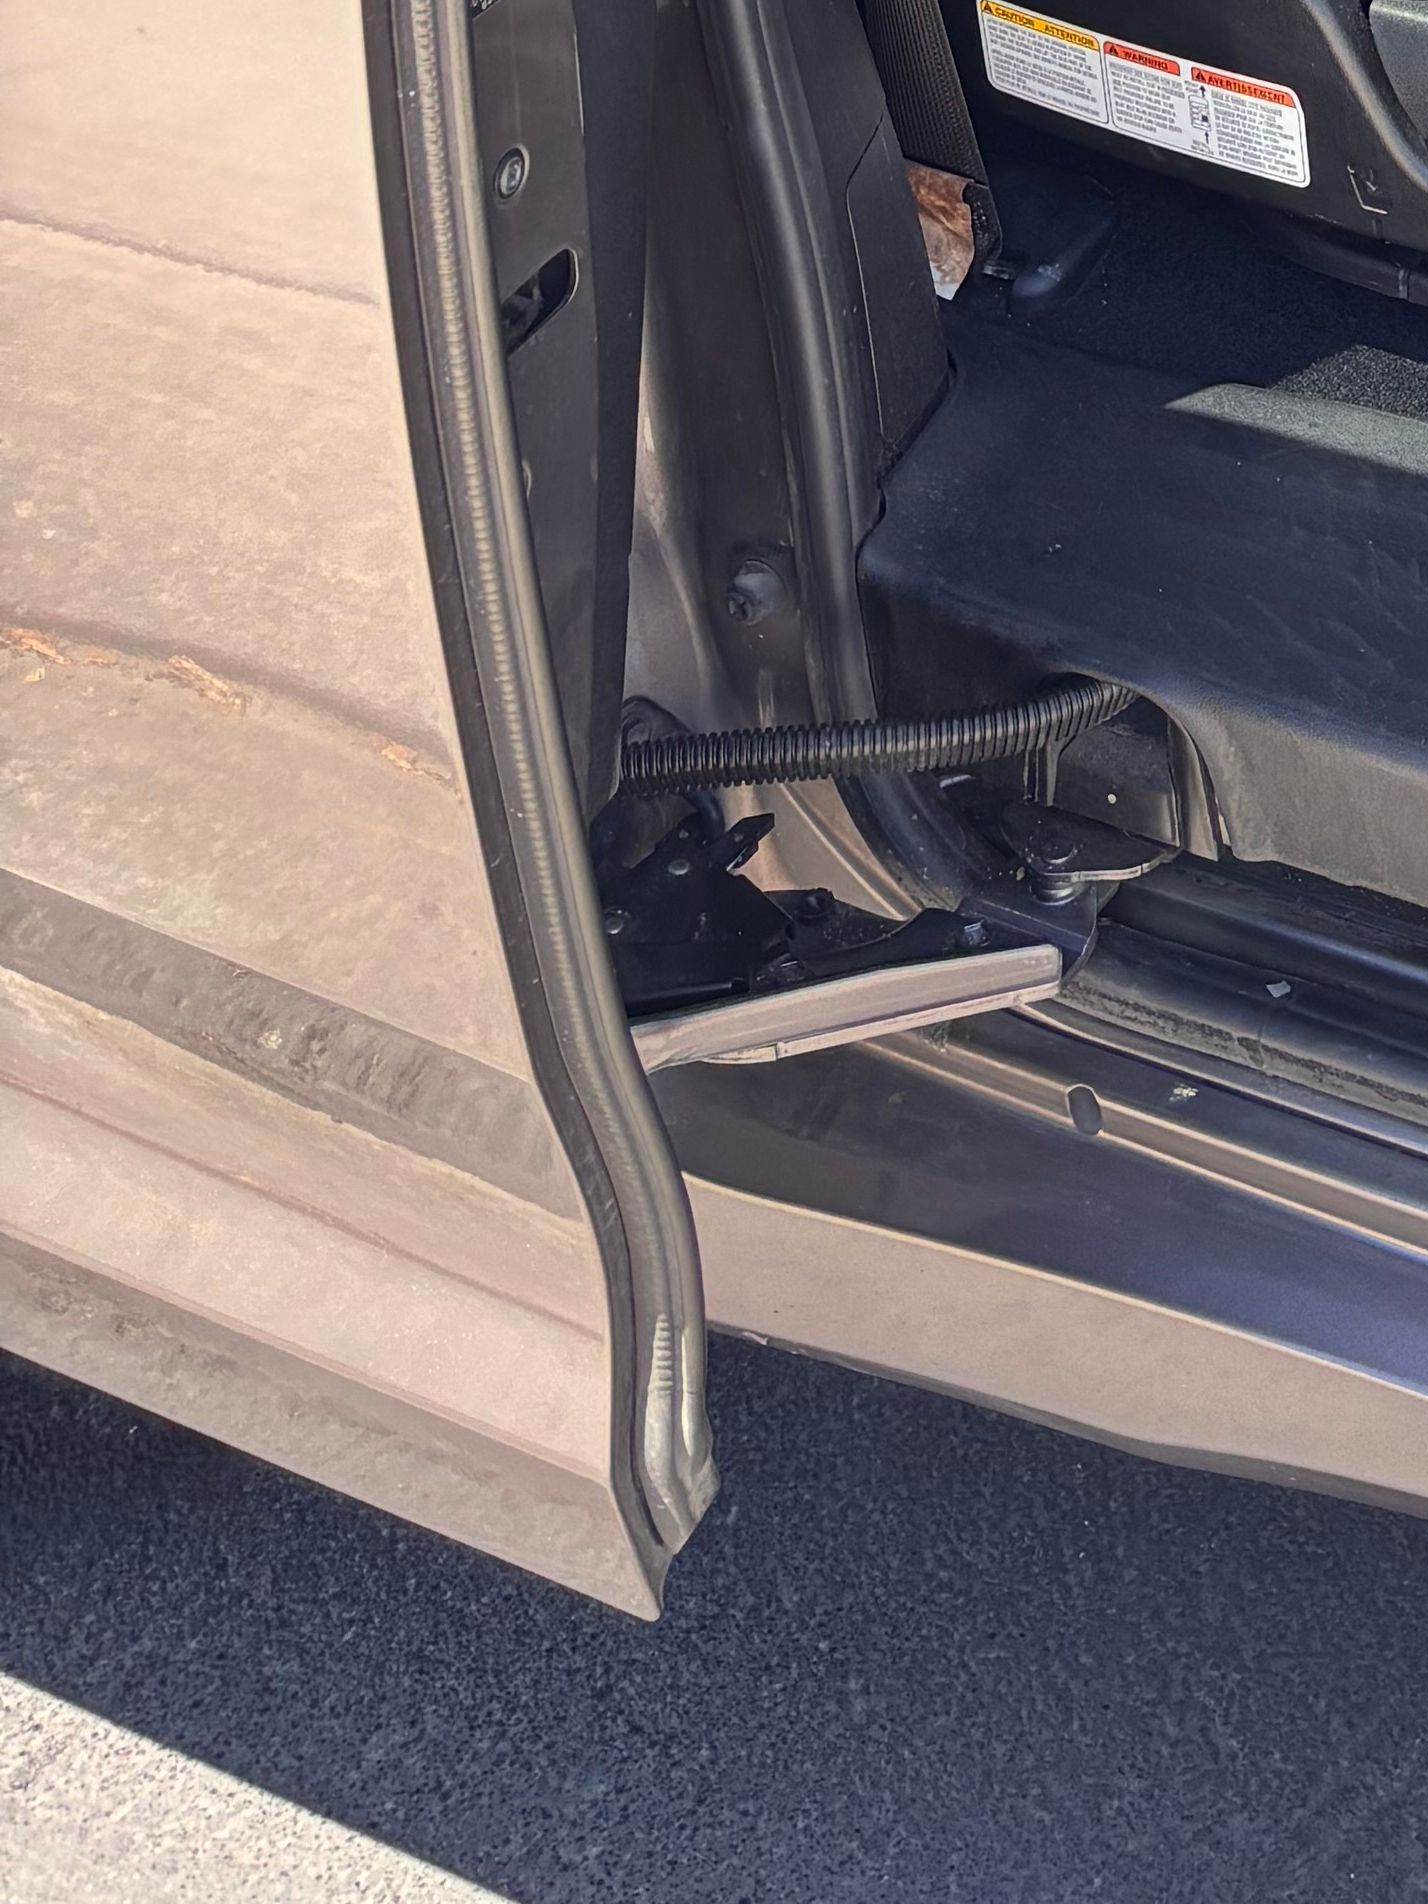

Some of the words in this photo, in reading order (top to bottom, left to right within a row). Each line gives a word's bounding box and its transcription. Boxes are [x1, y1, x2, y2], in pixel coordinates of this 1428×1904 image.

[995, 6, 1035, 28] CAUTION
[1044, 24, 1094, 48] ATTENTION
[1123, 51, 1168, 70] WARNING
[1208, 76, 1286, 104] AVERTISSEMENT
